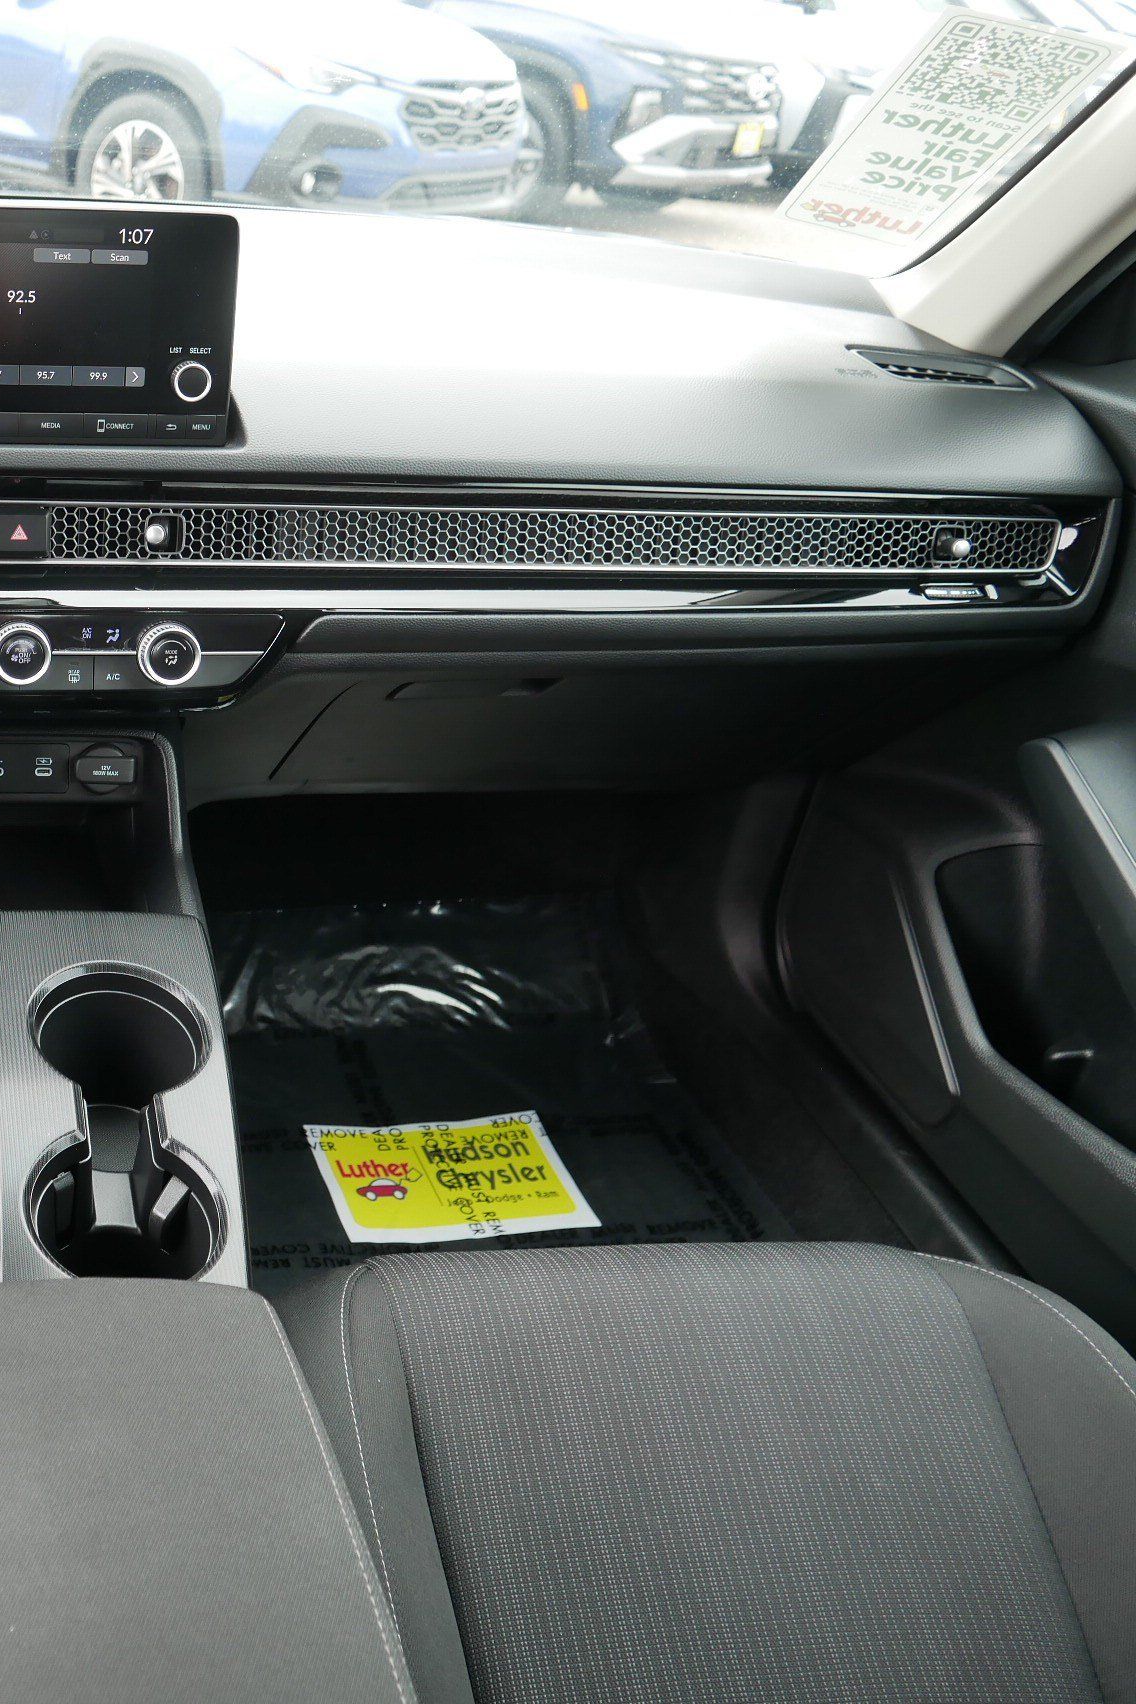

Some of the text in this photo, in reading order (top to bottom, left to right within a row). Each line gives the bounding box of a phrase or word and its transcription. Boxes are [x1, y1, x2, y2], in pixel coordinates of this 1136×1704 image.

[117, 228, 154, 245] 1:07
[53, 252, 71, 261] Text
[110, 253, 129, 262] Scan
[7, 290, 36, 304] 92.5
[169, 346, 183, 354] LIST
[189, 347, 212, 355] SELECT
[36, 371, 55, 380] 95.7
[89, 372, 108, 381] 99.9
[41, 421, 61, 429] MEDIA
[106, 422, 134, 430] CONNECT
[191, 423, 211, 431] MENU
[421, 1139, 531, 1165] Hudson
[336, 1159, 410, 1179] Luther
[436, 1162, 548, 1191] Chrysler
[485, 1194, 524, 1204] Dodge
[536, 1190, 560, 1198] Ram
[250, 1258, 289, 1269] REM
